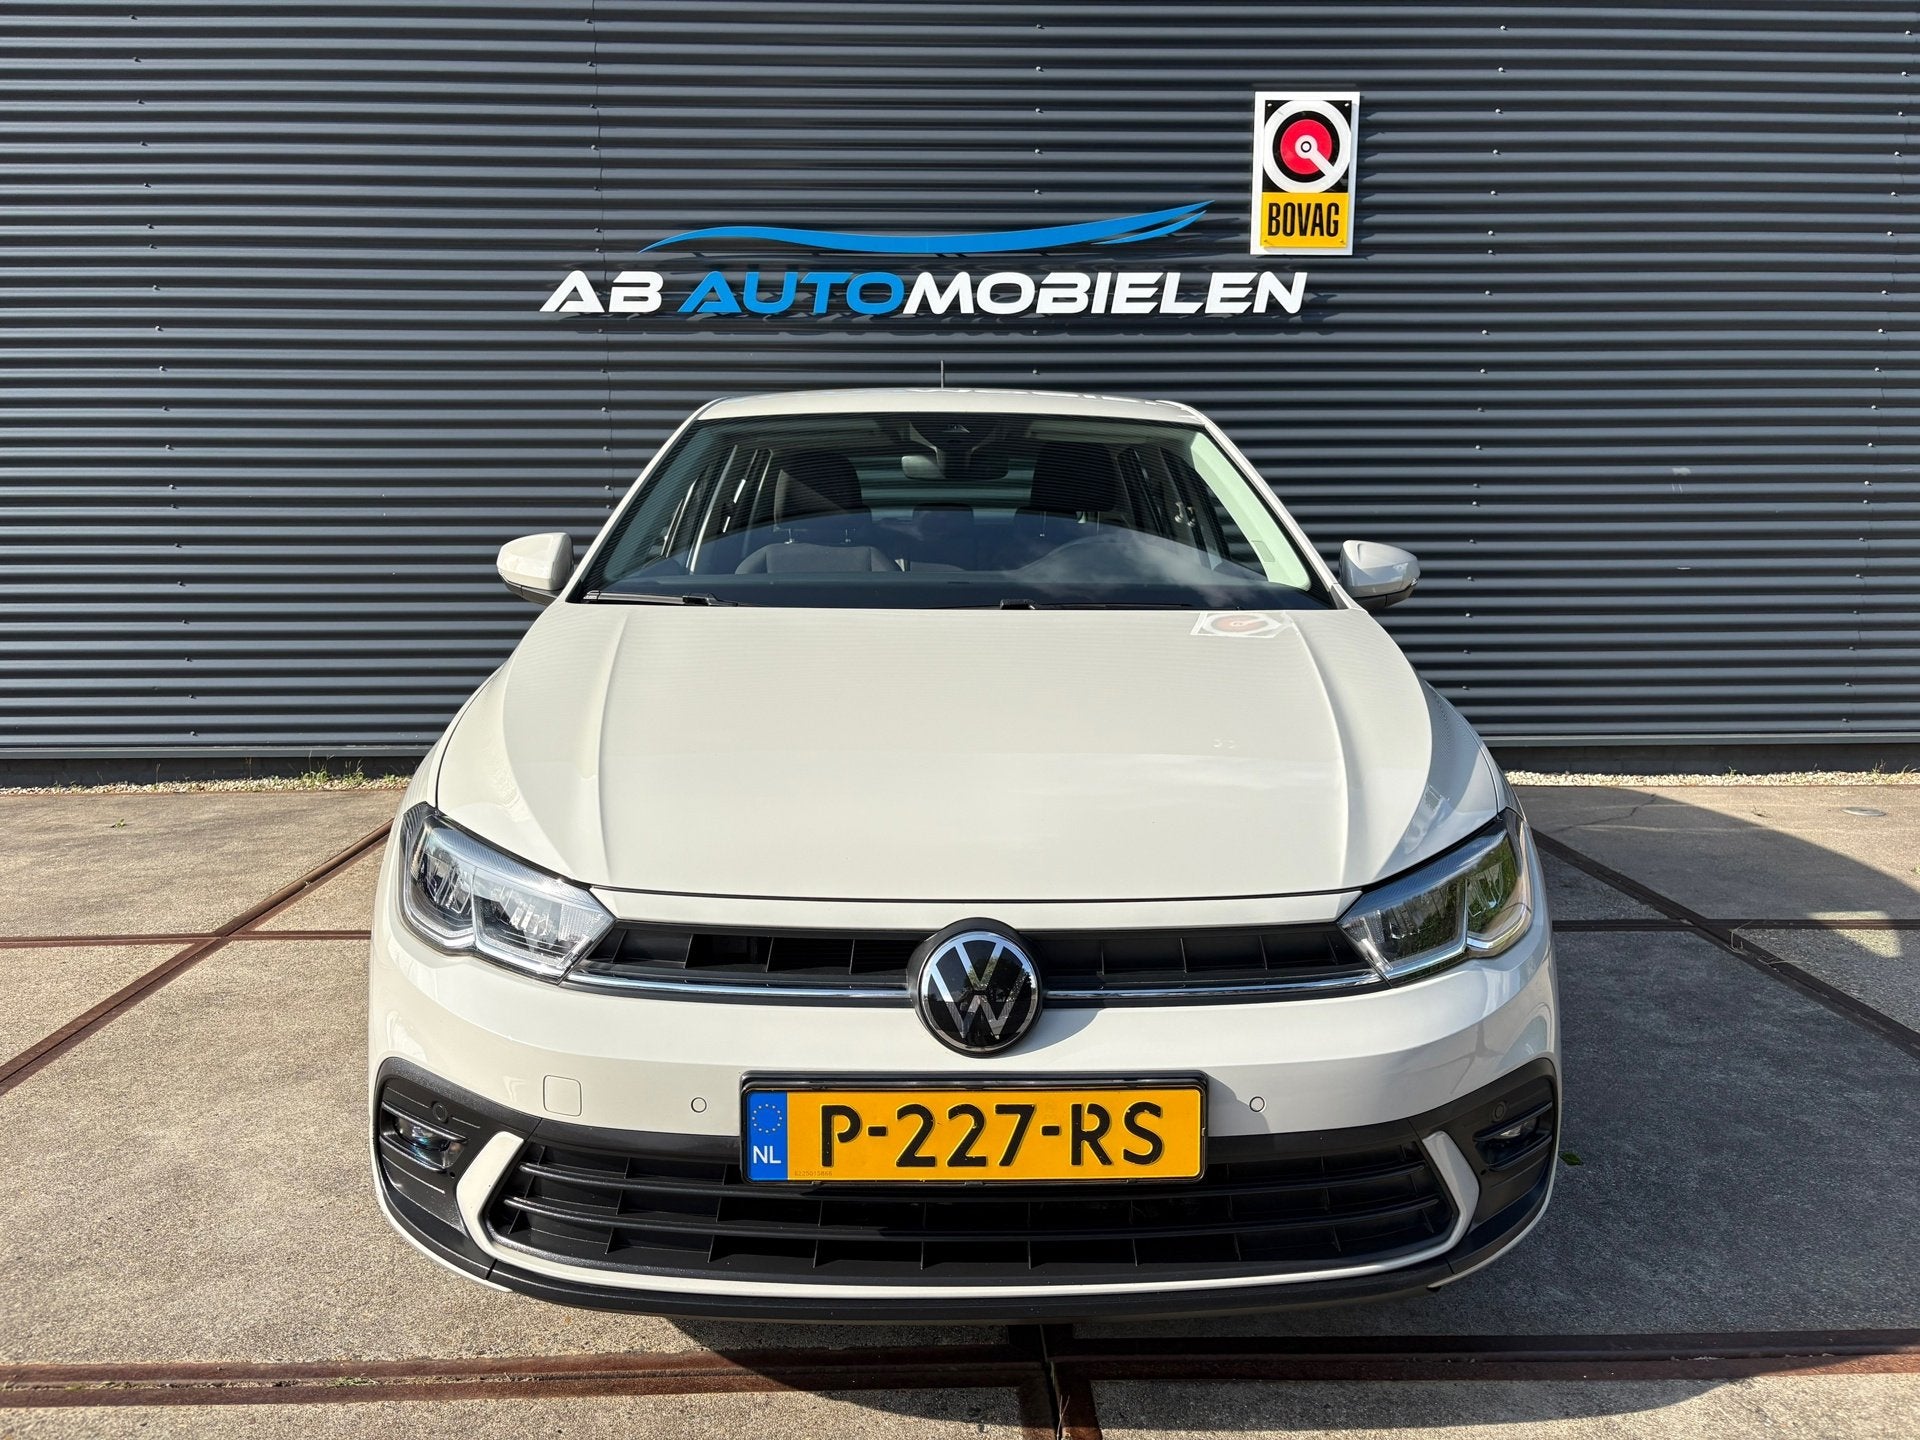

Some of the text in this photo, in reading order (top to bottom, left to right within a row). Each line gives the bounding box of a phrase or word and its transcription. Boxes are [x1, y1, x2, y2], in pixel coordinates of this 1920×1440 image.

[1267, 202, 1340, 237] BOVAG
[539, 270, 1308, 315] AB AUTOMOBIELEN
[926, 935, 1034, 1044] VW
[753, 1145, 782, 1164] NL
[820, 1101, 1163, 1168] P-227-RS
